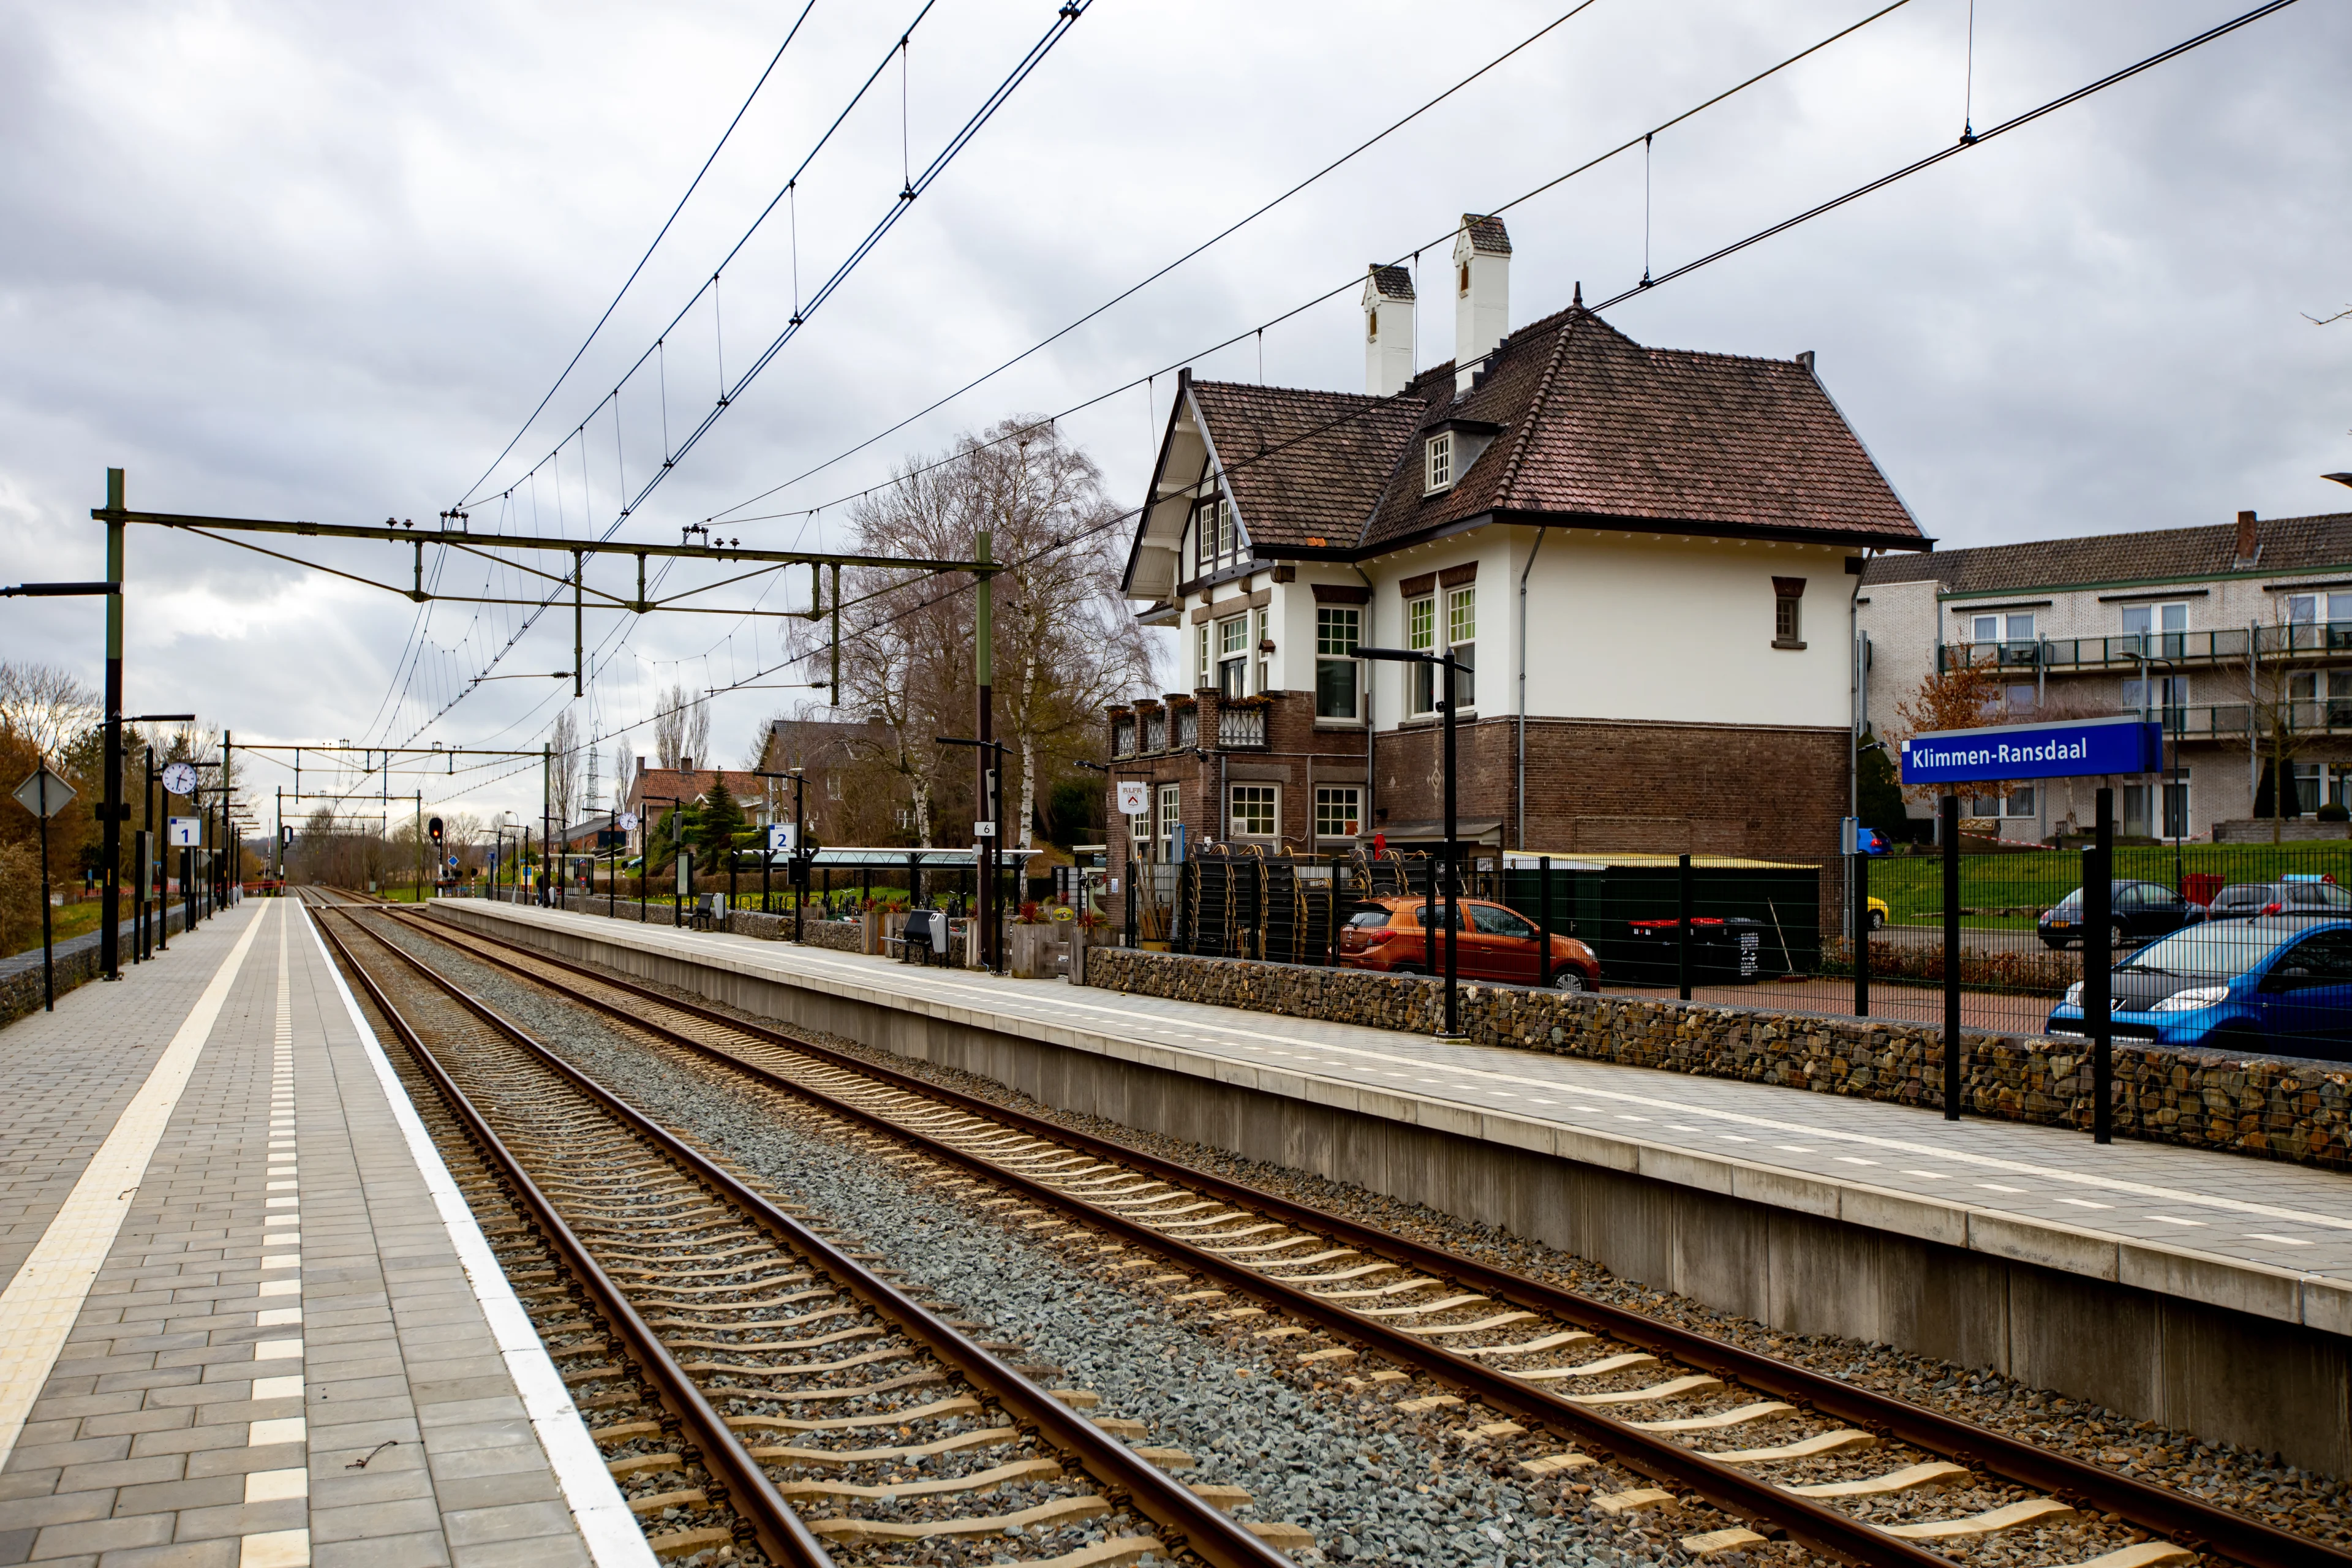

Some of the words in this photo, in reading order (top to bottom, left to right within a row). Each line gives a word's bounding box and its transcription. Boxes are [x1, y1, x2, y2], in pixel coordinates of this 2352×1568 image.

[1913, 737, 2087, 767] Klimmen-Ransdaal
[984, 824, 990, 834] 6
[181, 829, 188, 843] 1
[778, 834, 786, 846] 2
